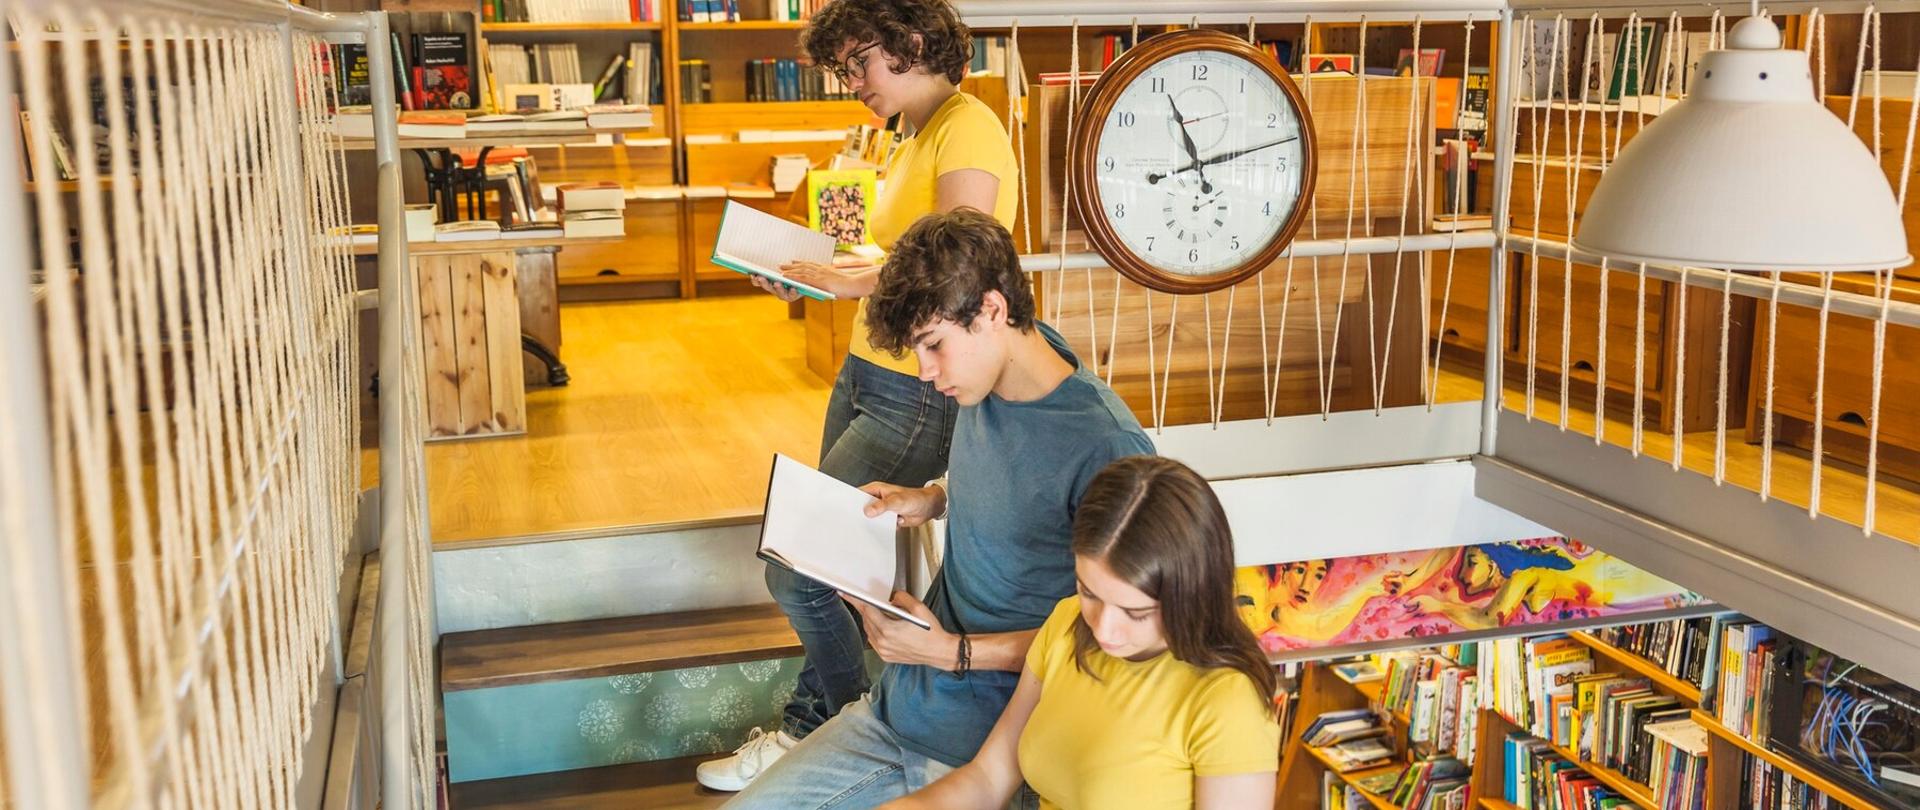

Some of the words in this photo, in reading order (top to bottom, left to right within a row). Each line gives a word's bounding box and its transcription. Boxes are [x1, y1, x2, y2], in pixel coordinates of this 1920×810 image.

[1192, 65, 1208, 81] 12
[1152, 77, 1165, 93] 11
[1239, 78, 1245, 93] 1
[1118, 112, 1136, 128] 10
[1266, 113, 1277, 129] 2
[1104, 157, 1115, 173] 9
[1276, 156, 1287, 173] 3
[1115, 204, 1125, 219] 8
[1261, 201, 1271, 217] 4
[1145, 236, 1155, 252] 7
[1230, 235, 1240, 251] 5
[1188, 248, 1199, 263] 6
